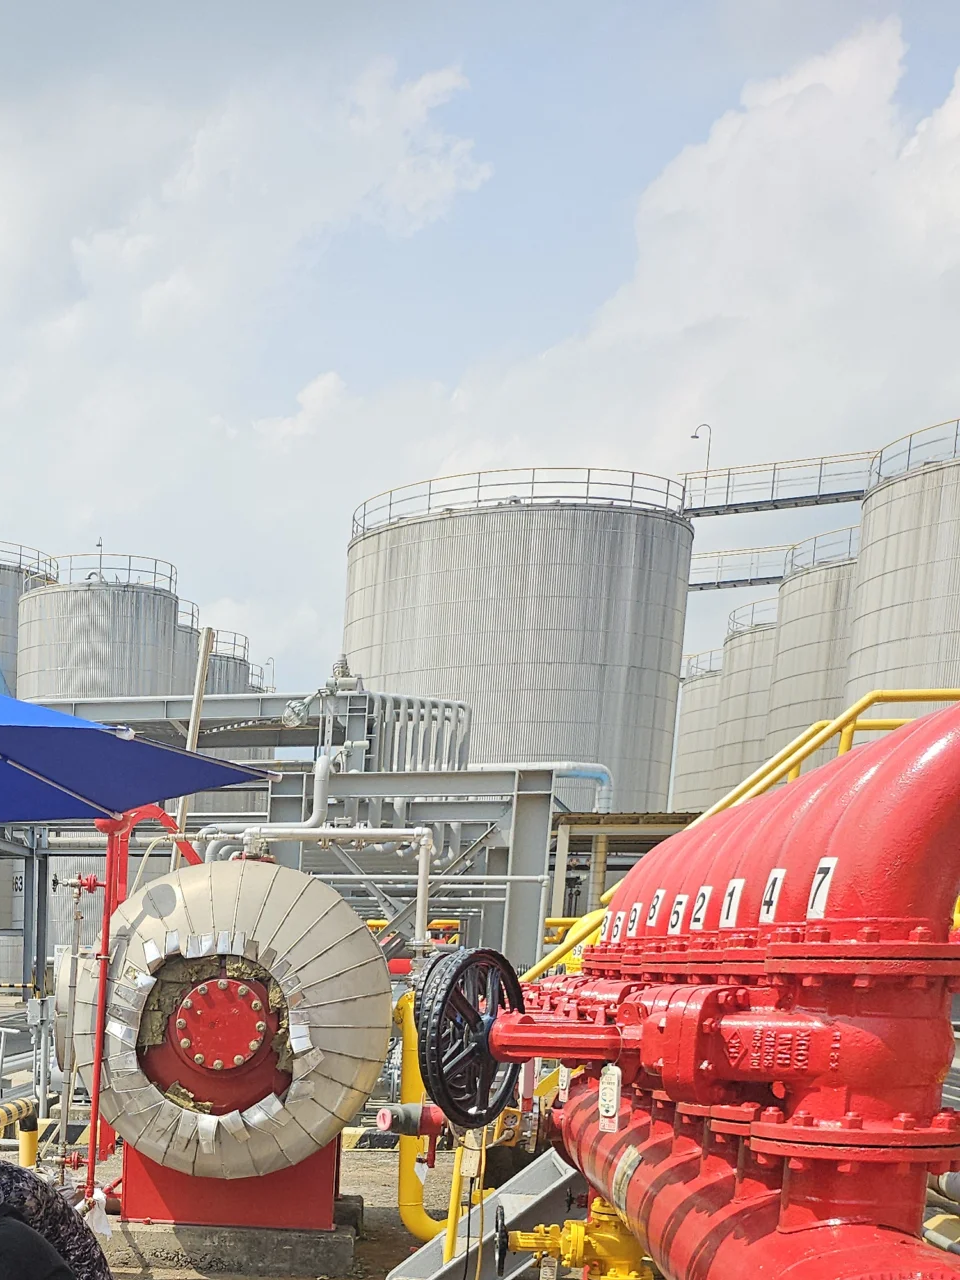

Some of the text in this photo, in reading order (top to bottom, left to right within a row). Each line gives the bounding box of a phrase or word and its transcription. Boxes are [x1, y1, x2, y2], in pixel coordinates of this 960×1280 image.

[12, 875, 23, 892] 63
[762, 876, 778, 915] 4
[809, 866, 832, 910] 7
[648, 894, 660, 921] 8
[670, 900, 683, 929] 5
[692, 892, 706, 923] 2
[726, 885, 736, 920] 1
[612, 916, 622, 939] 6
[628, 907, 638, 932] 9
[776, 1033, 794, 1065] HAN
[793, 1029, 812, 1070] KOOK
